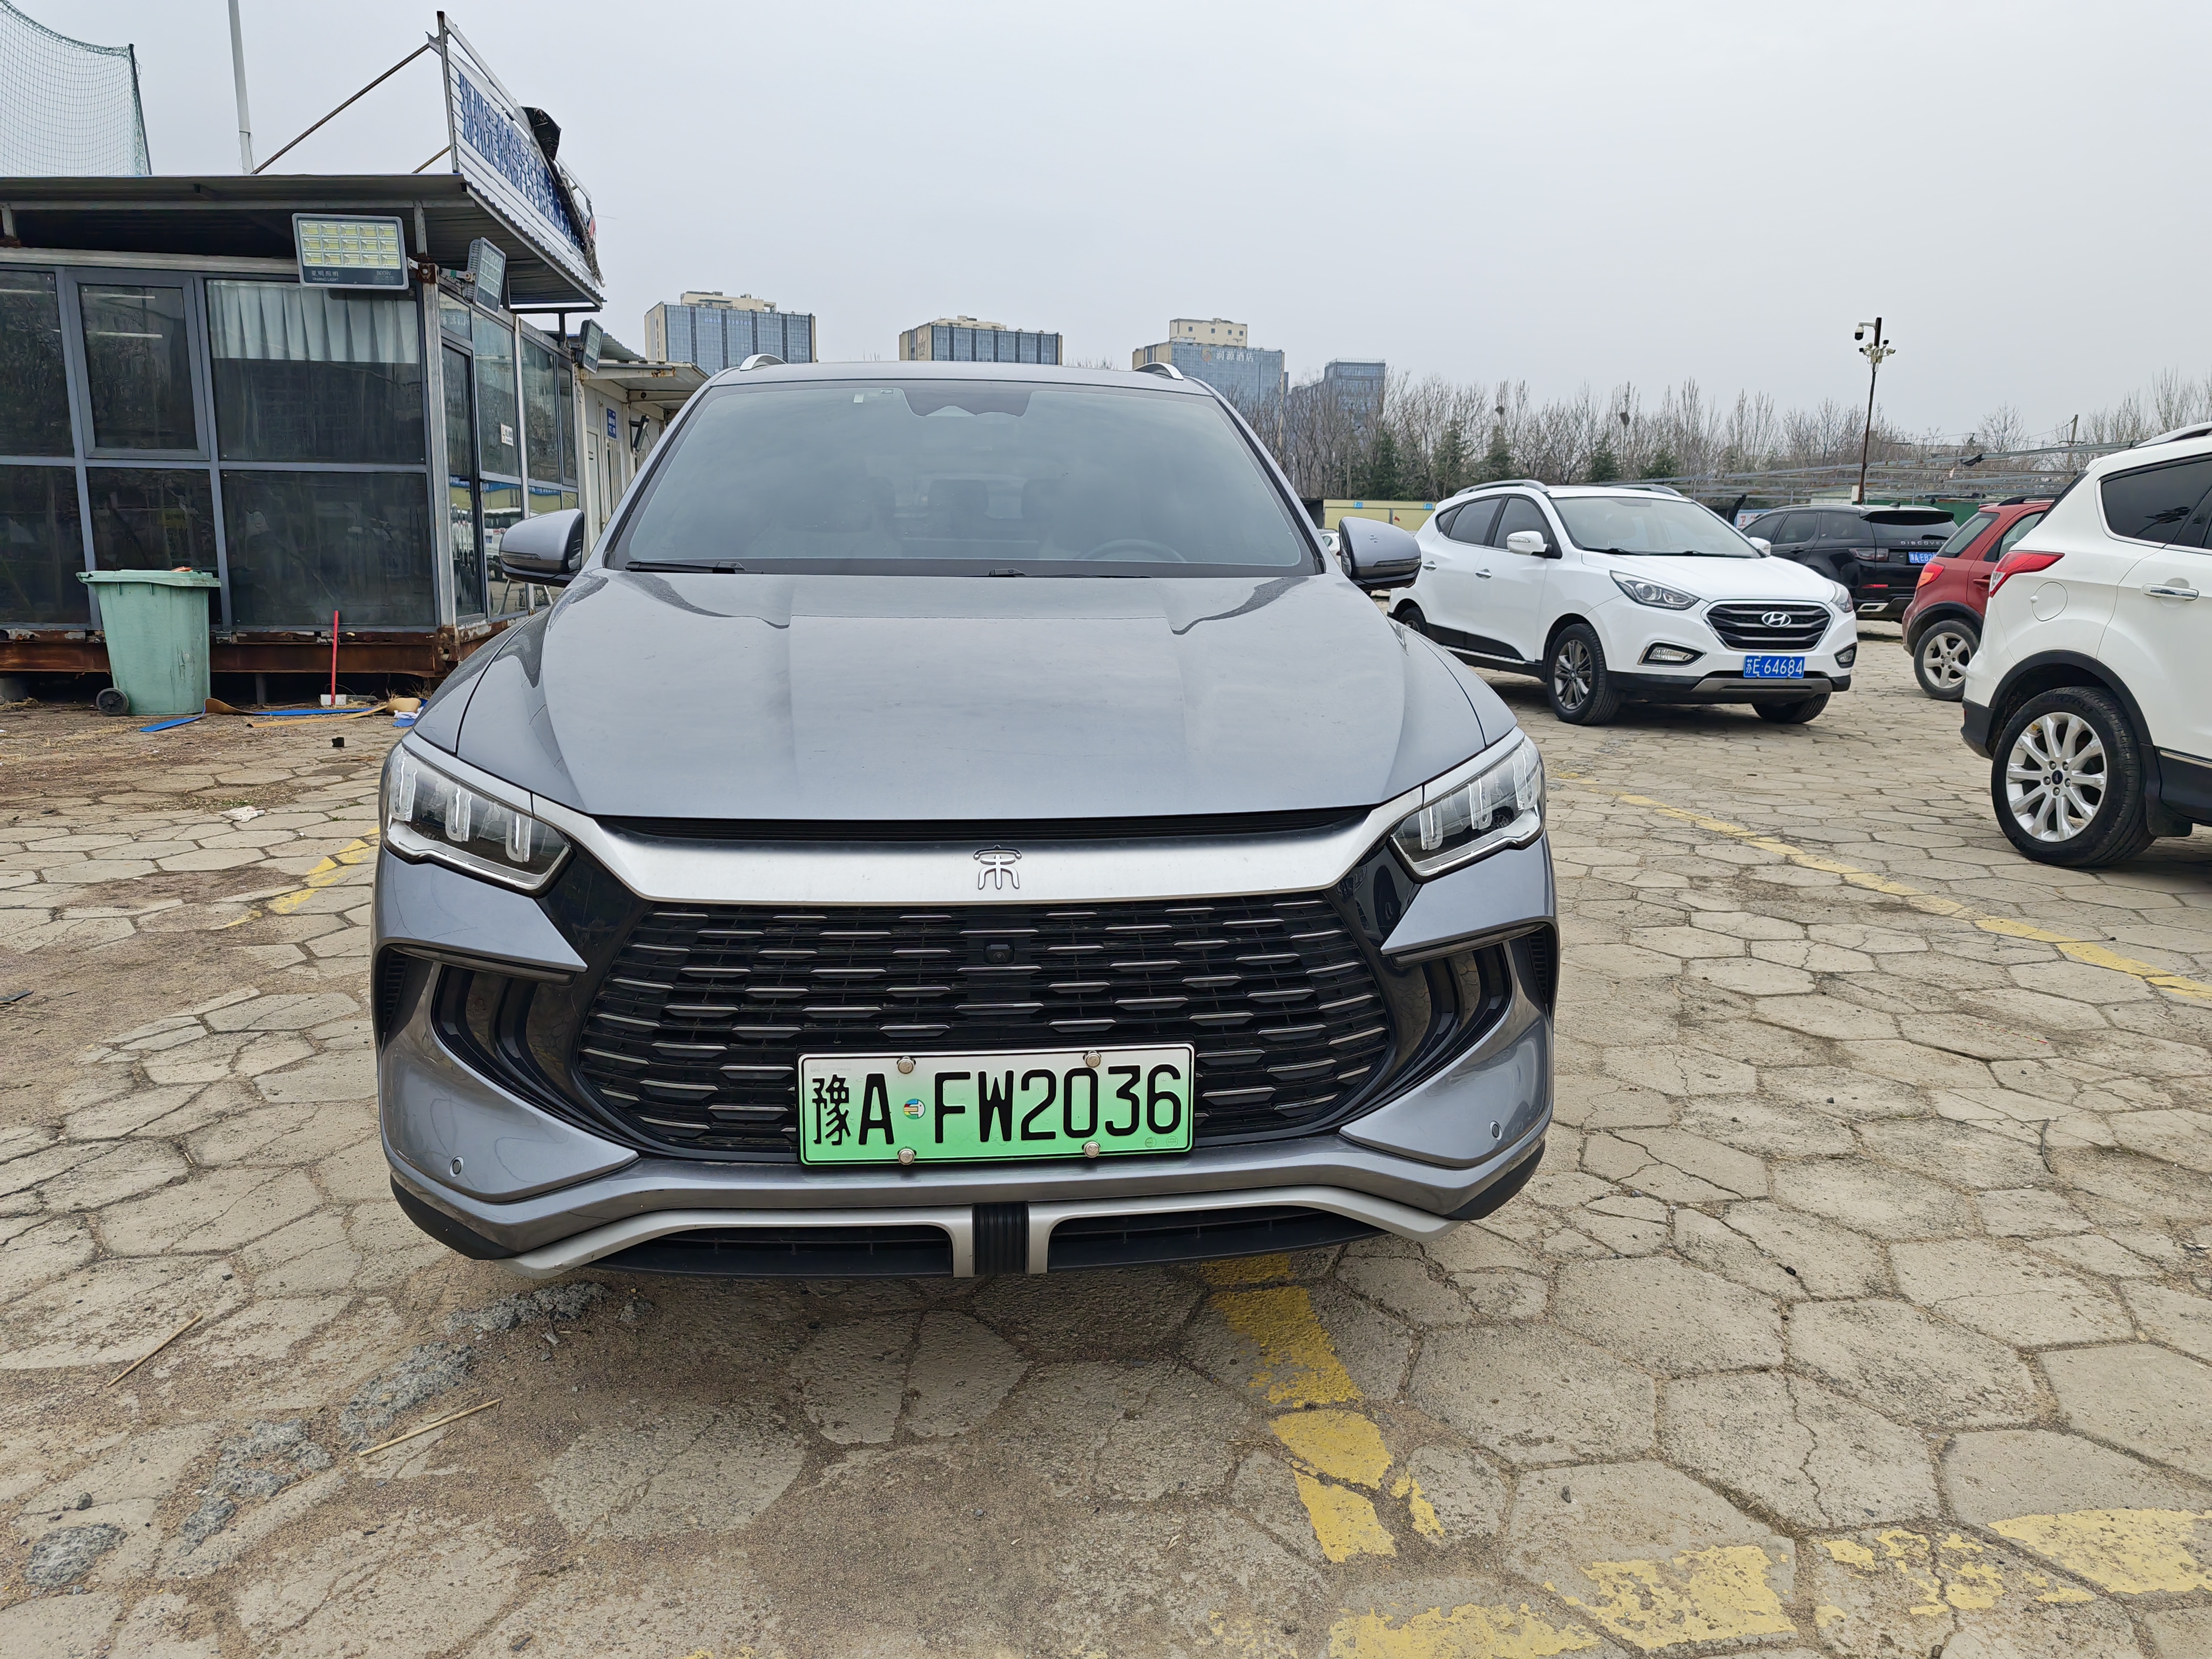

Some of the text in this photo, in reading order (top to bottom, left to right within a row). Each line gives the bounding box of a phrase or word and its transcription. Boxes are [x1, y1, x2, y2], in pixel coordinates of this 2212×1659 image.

[1216, 350, 1254, 362] 润源酒店
[812, 1064, 1182, 1146] 豫A FW2036
